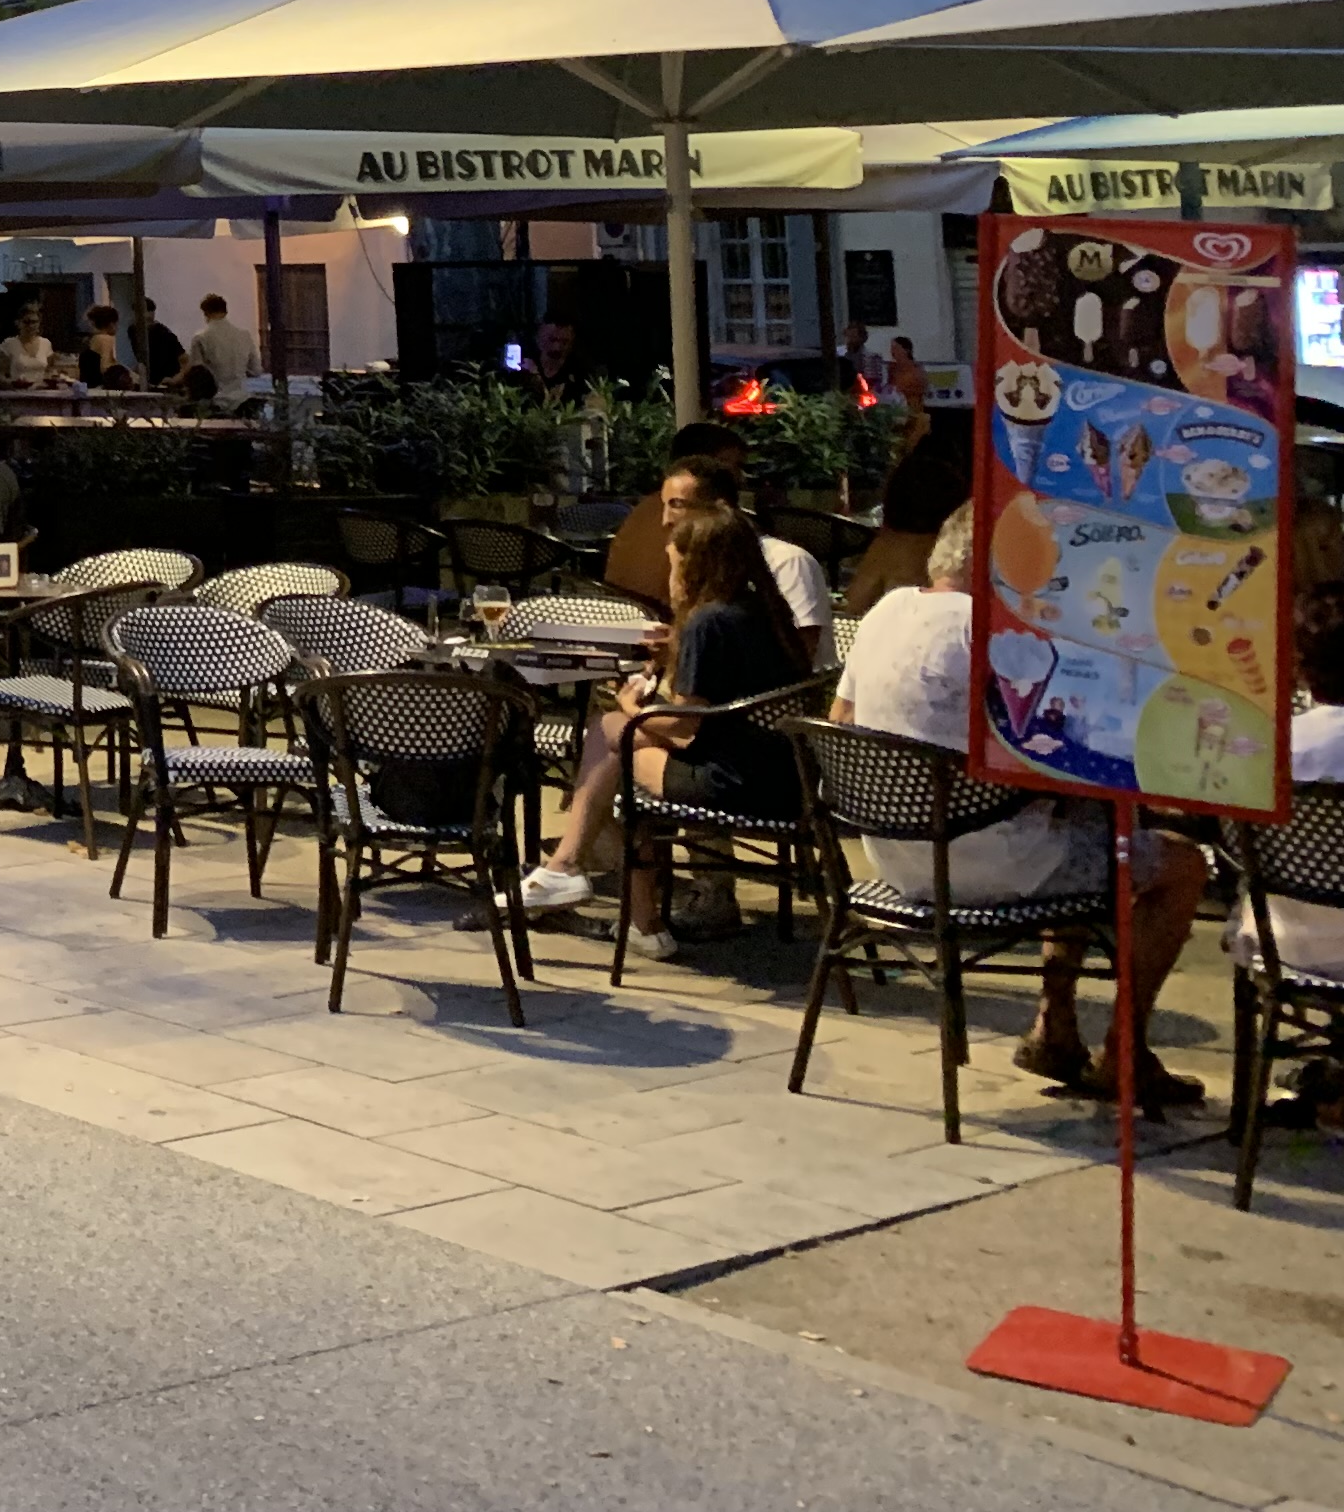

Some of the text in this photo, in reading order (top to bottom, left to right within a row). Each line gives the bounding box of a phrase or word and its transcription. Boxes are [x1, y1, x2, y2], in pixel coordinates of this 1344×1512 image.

[357, 148, 704, 182] AU BISTROT MARN
[1047, 173, 1086, 203] AU
[1090, 169, 1211, 201] BISTRT
[1079, 250, 1102, 269] M
[451, 645, 490, 659] pizza
